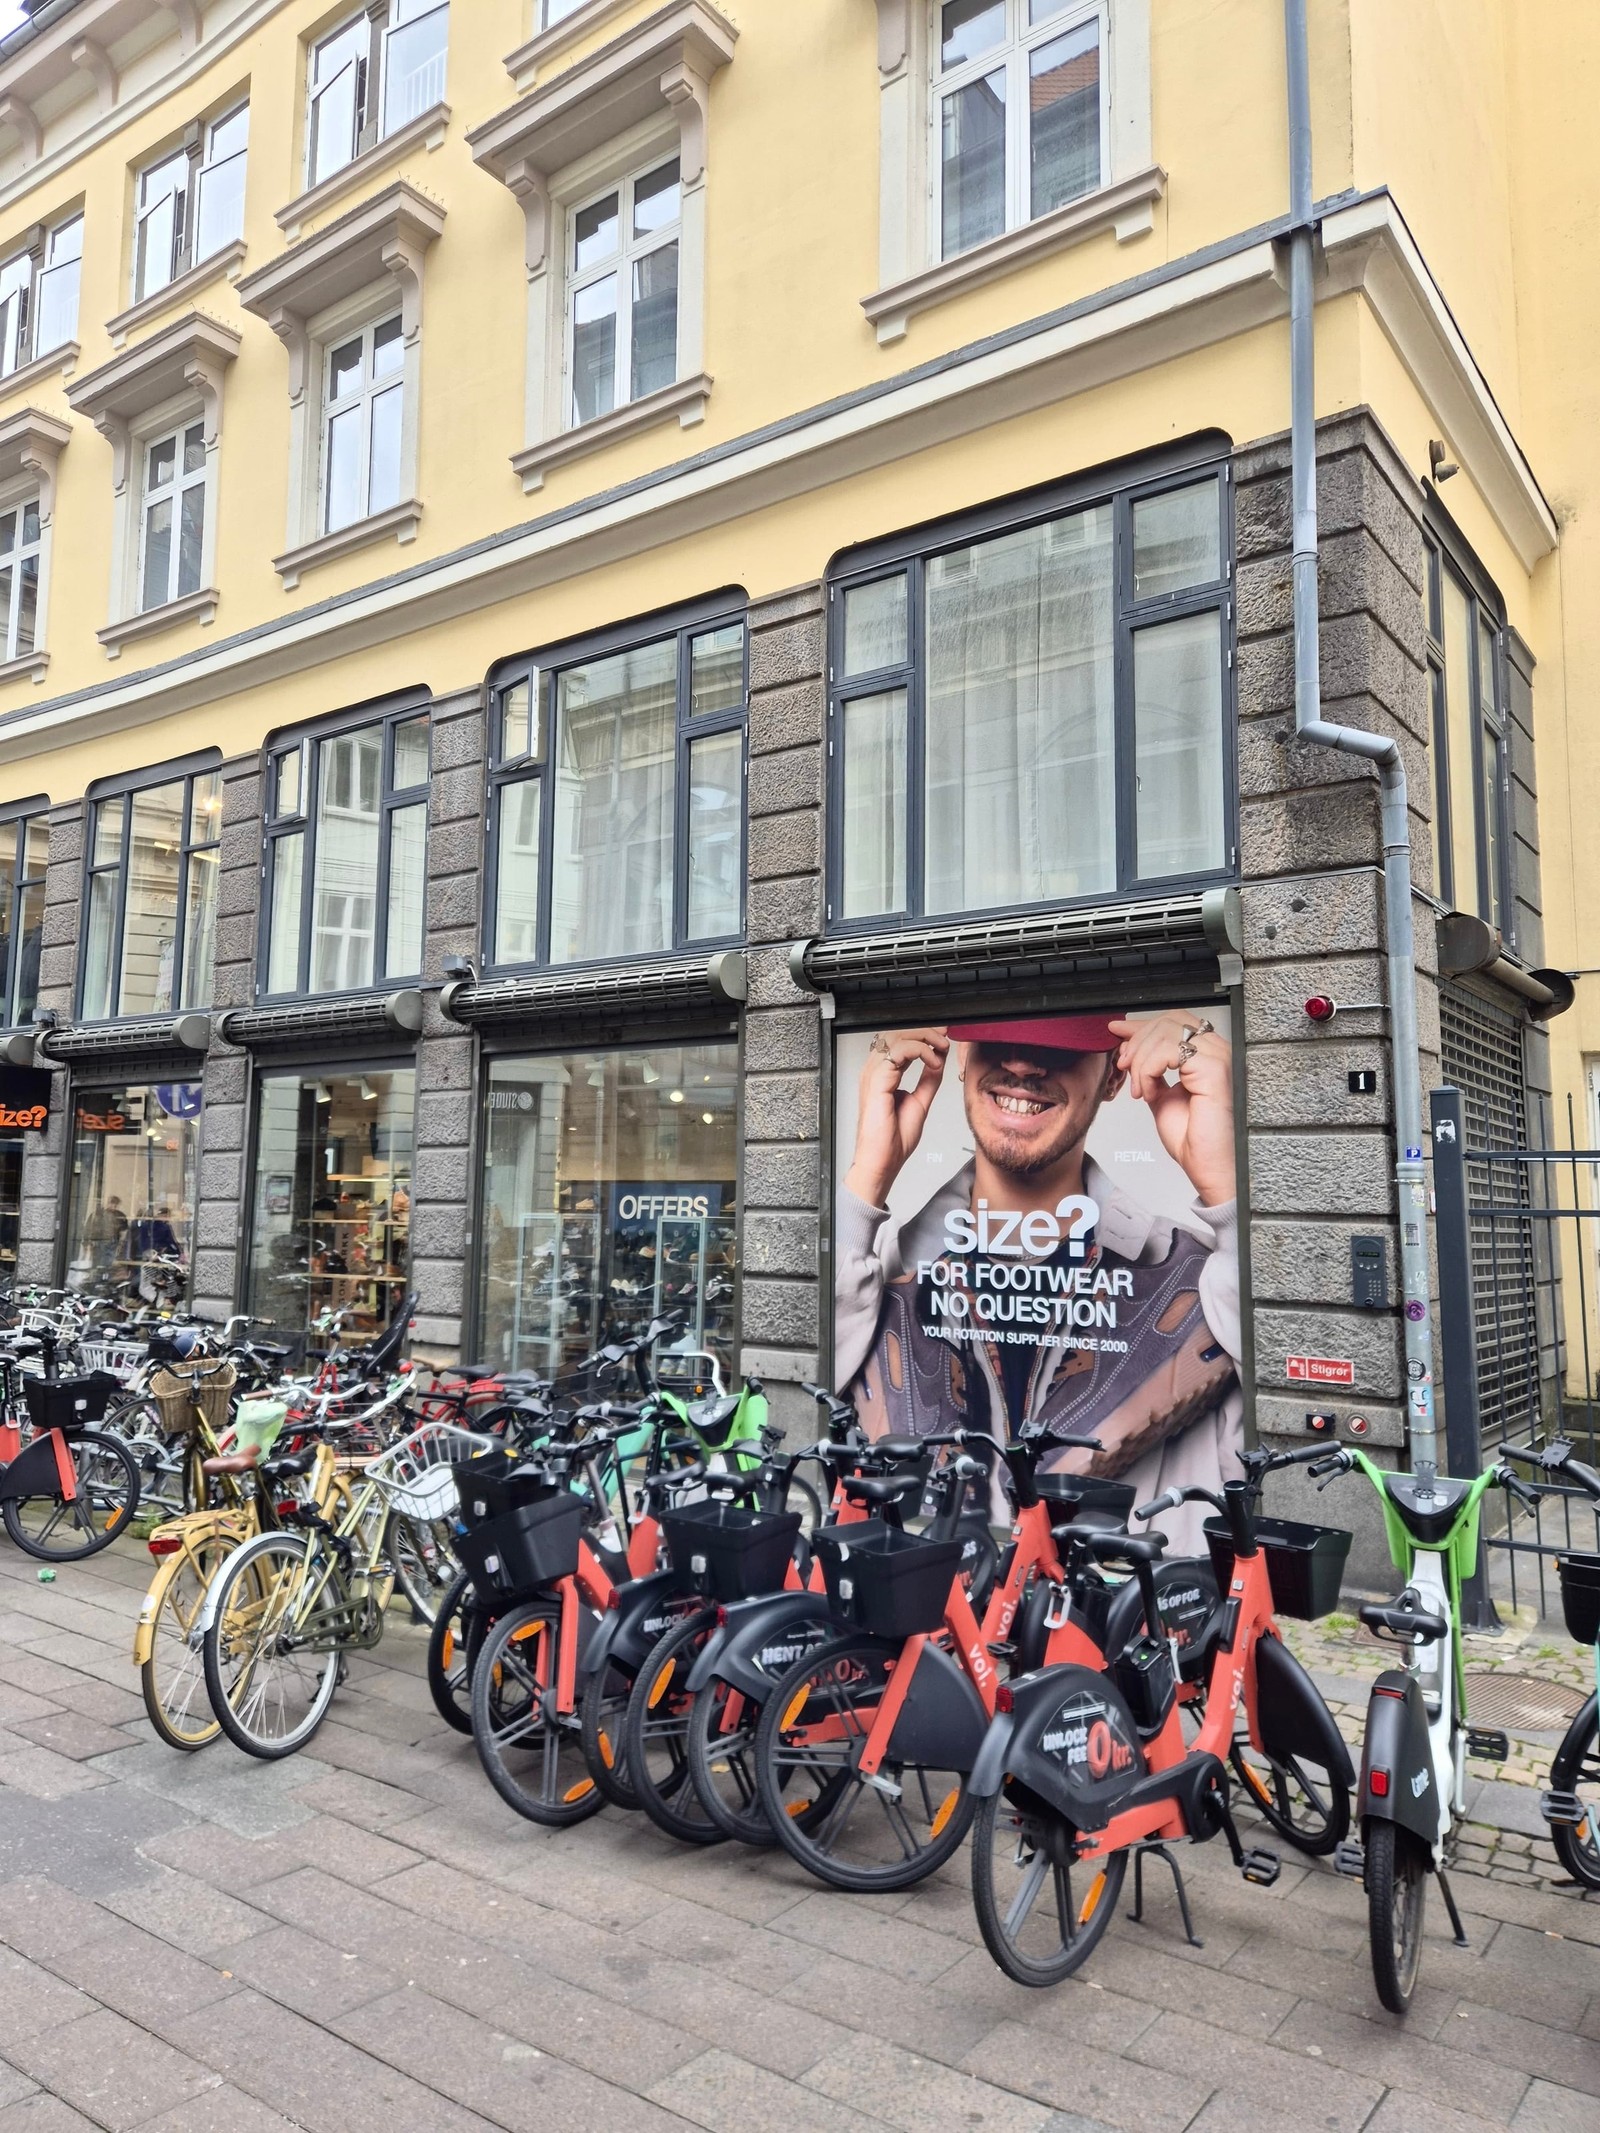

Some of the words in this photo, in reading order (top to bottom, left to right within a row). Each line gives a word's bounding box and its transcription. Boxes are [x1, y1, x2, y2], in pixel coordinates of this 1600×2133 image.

[1358, 1072, 1366, 1090] 1
[0, 1103, 47, 1128] ize?
[1114, 1151, 1156, 1163] RETAIL
[619, 1195, 709, 1220] OFFERS
[943, 1195, 1100, 1257] size?
[917, 1260, 968, 1288] FOR
[975, 1263, 1134, 1297] FOOTWEAR
[931, 1291, 969, 1318] NO
[975, 1293, 1117, 1328] QUESTION
[922, 1325, 951, 1338] YOUR
[953, 1327, 1004, 1343] ROTATION
[1006, 1331, 1061, 1348] SUPPLIER
[1062, 1336, 1098, 1350] SINCE
[1100, 1339, 1129, 1353] 2000
[996, 1600, 1017, 1637] voi.
[762, 1645, 804, 1666] HENT
[970, 1643, 993, 1688] voi.
[1043, 1727, 1087, 1753] UNLOCK
[1067, 1745, 1087, 1766] FEE
